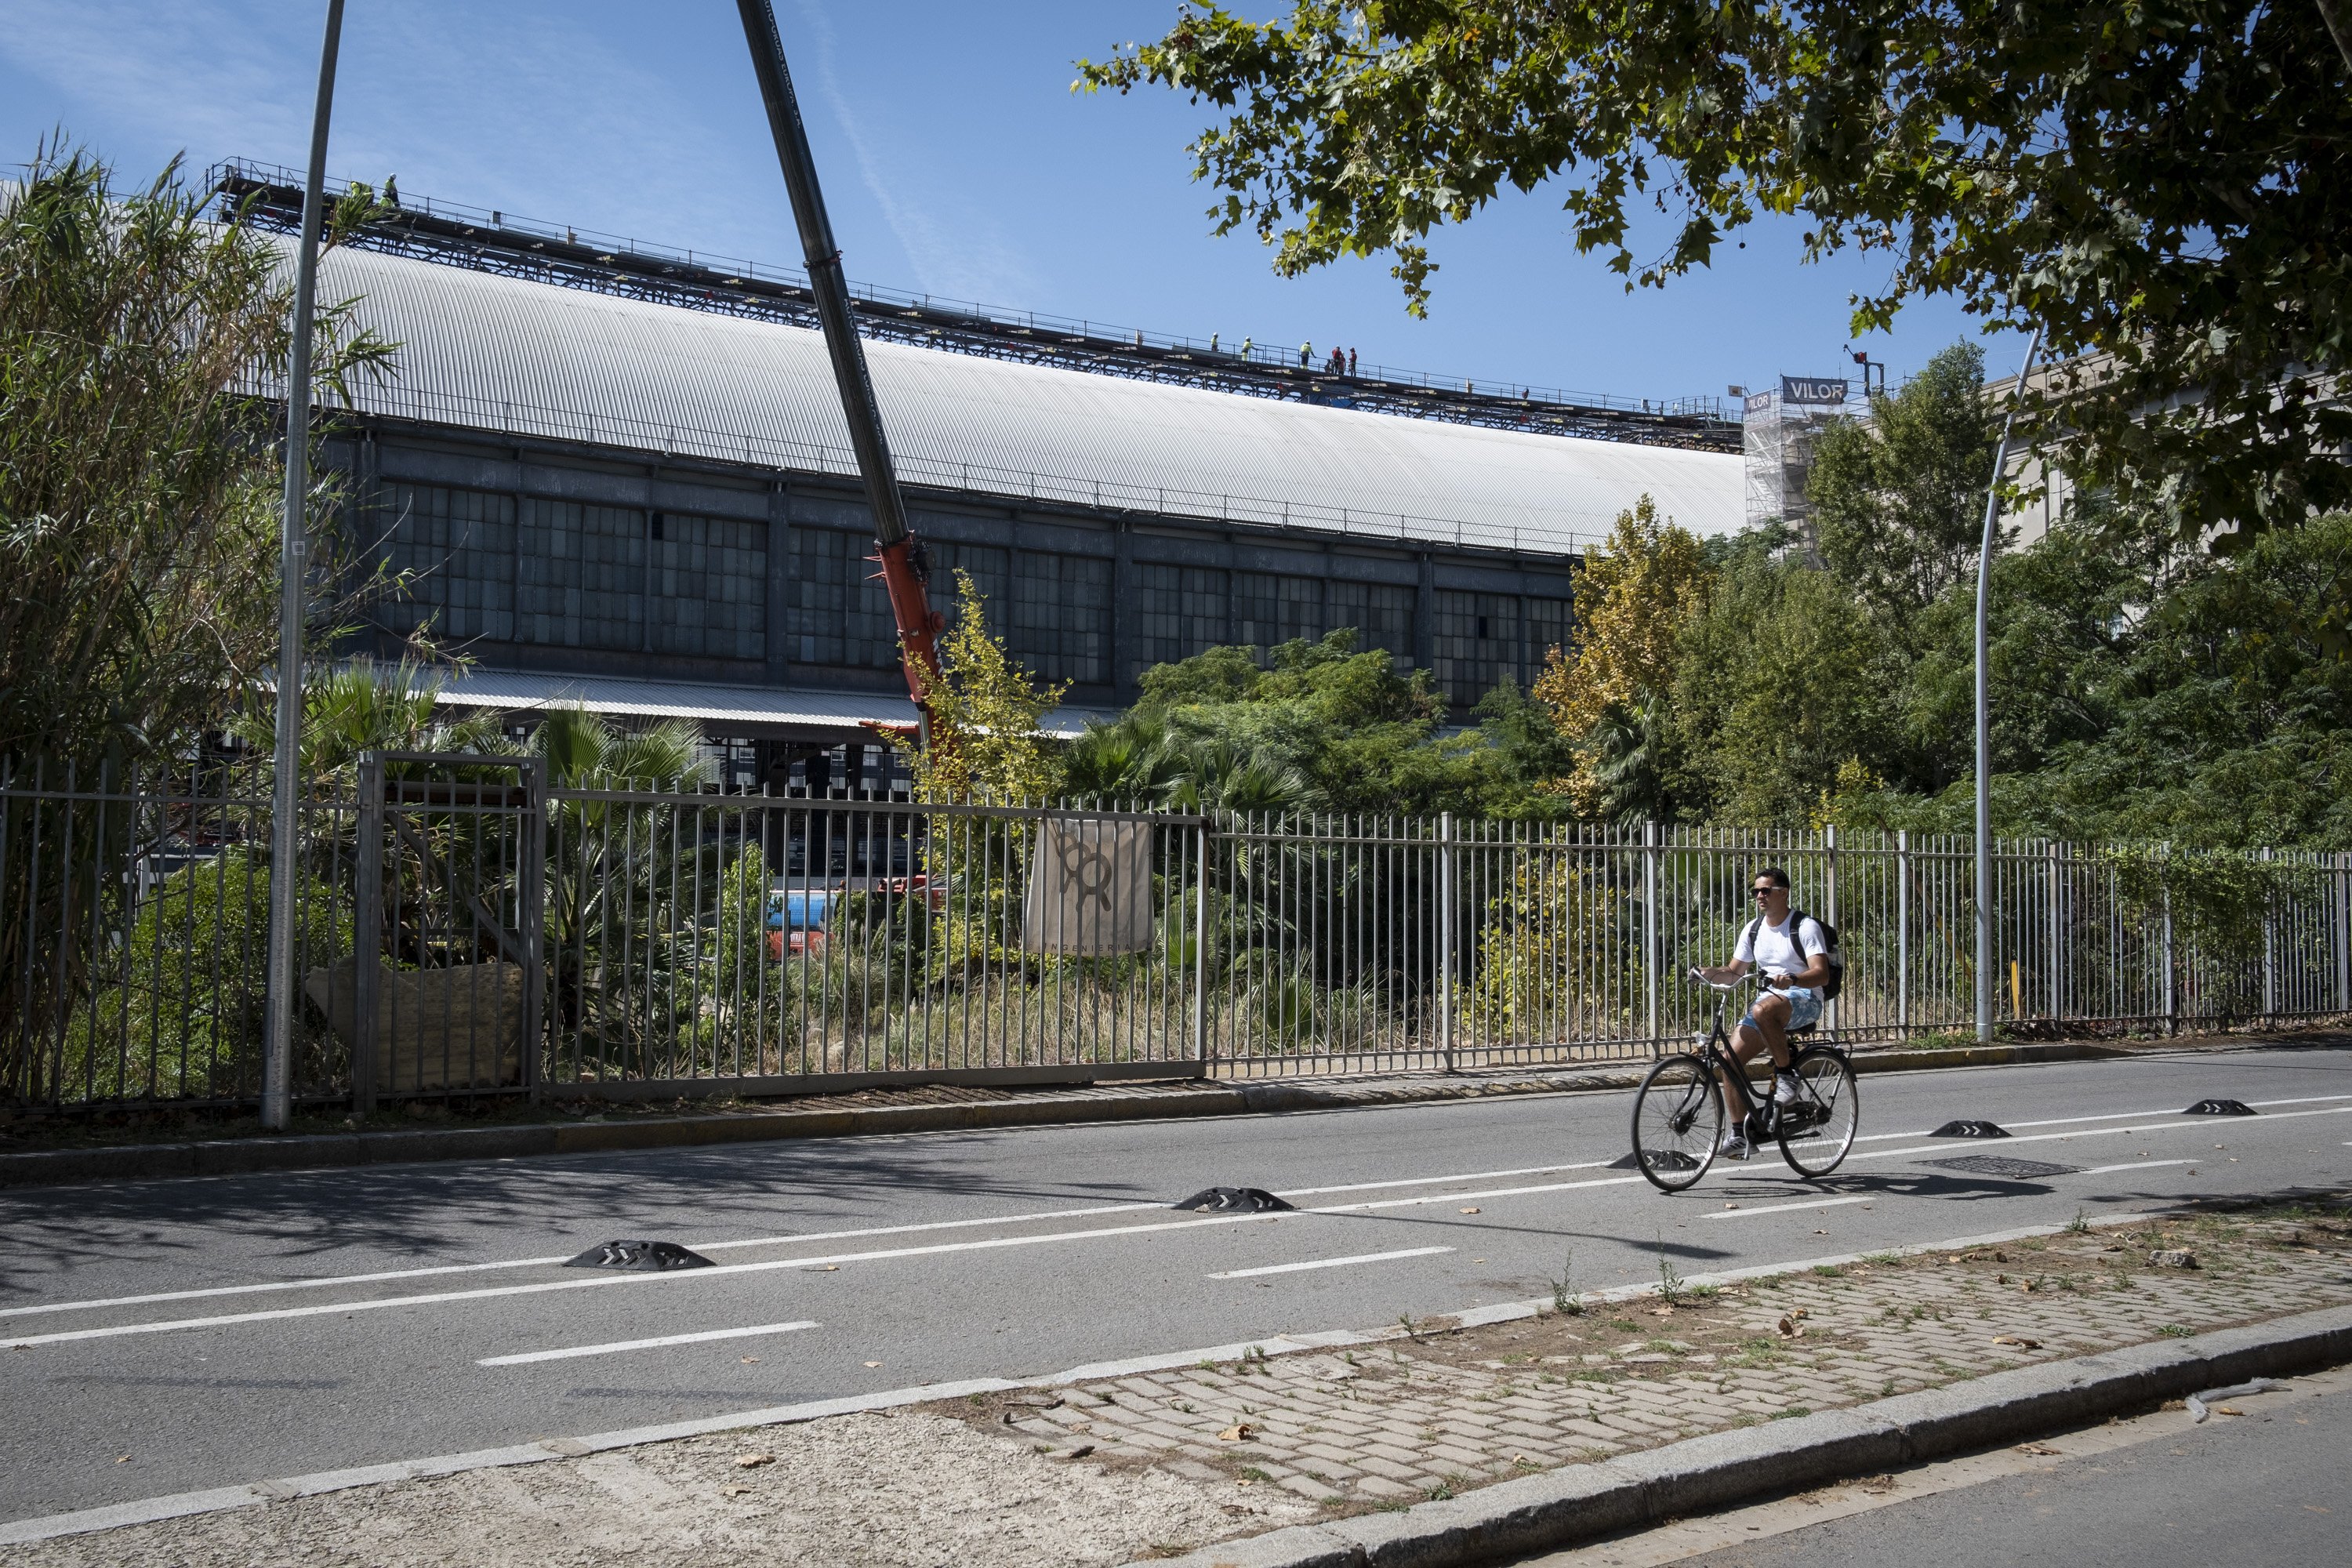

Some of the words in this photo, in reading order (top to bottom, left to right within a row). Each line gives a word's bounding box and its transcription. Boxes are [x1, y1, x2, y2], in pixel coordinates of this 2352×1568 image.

[764, 0, 783, 61] UTO-GRUAS
[1790, 382, 1843, 399] VILOR
[1044, 943, 1131, 953] INGENIERIA
